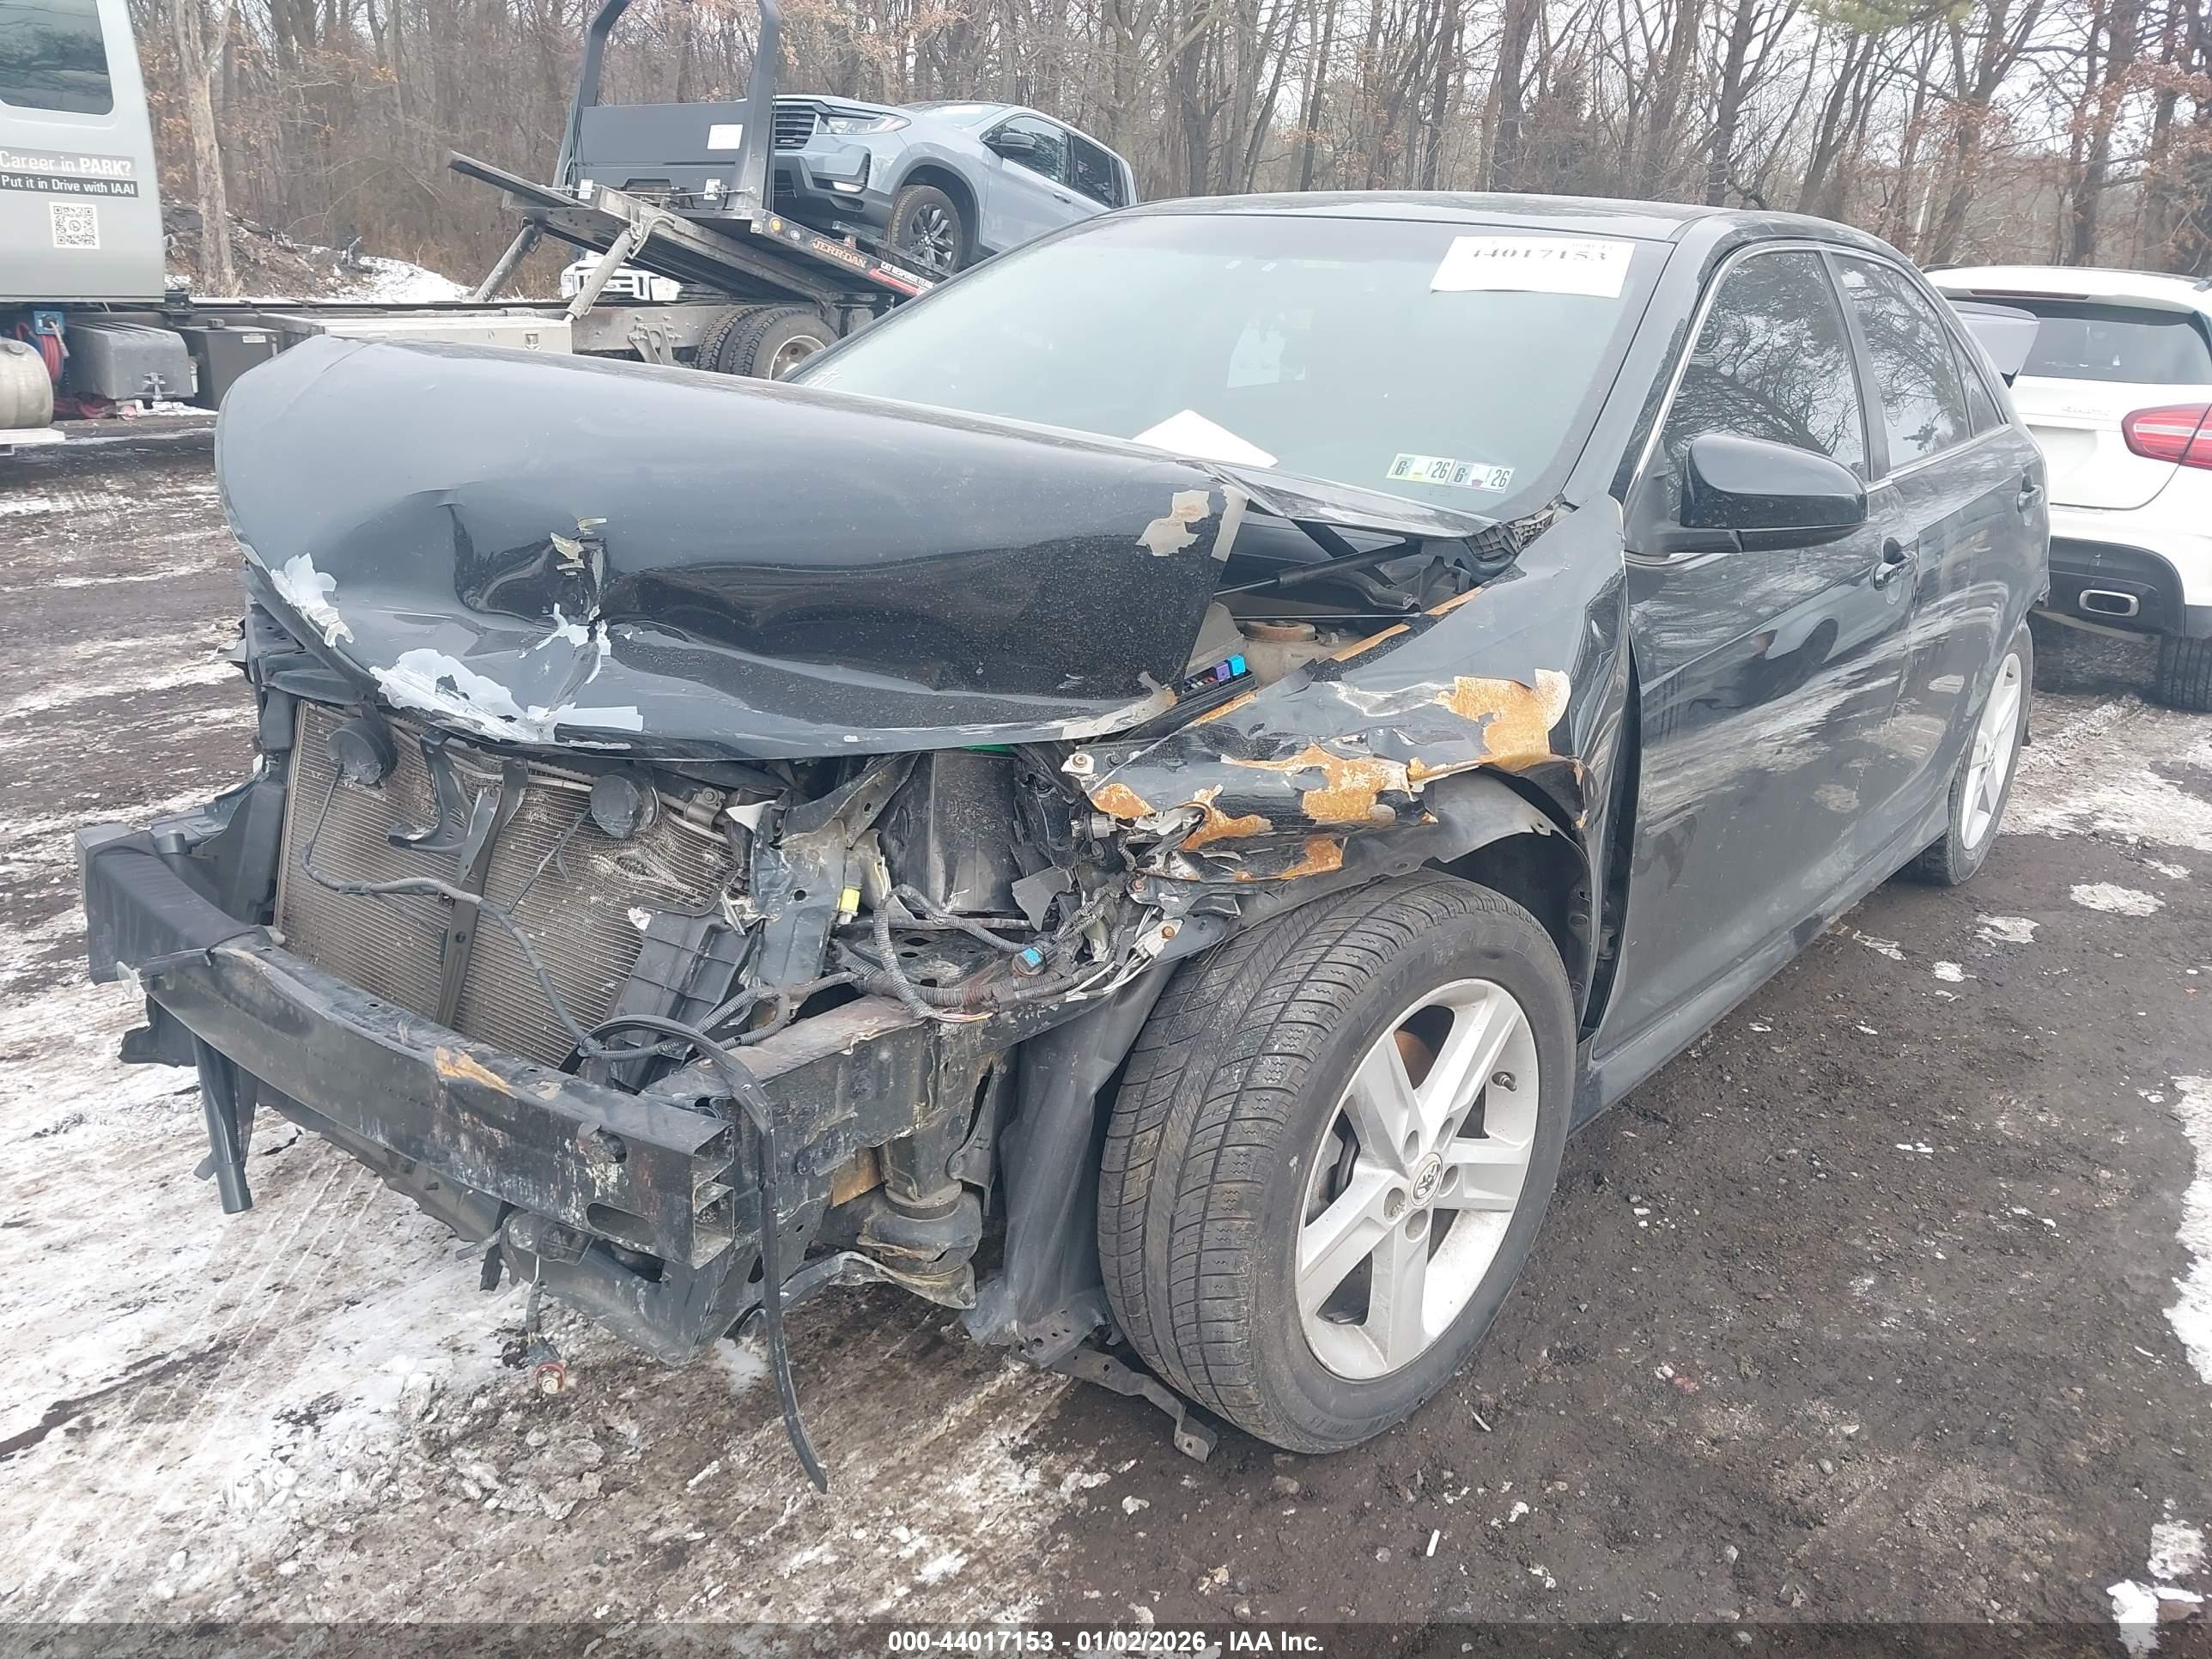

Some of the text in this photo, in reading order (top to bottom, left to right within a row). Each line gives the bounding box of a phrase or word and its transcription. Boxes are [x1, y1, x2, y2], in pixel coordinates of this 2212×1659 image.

[0, 150, 131, 177] Career in PARK?
[1, 174, 135, 195] Put it in Drive with IAAI
[1394, 459, 1450, 479] 6 26
[1453, 466, 1510, 488] 6 26
